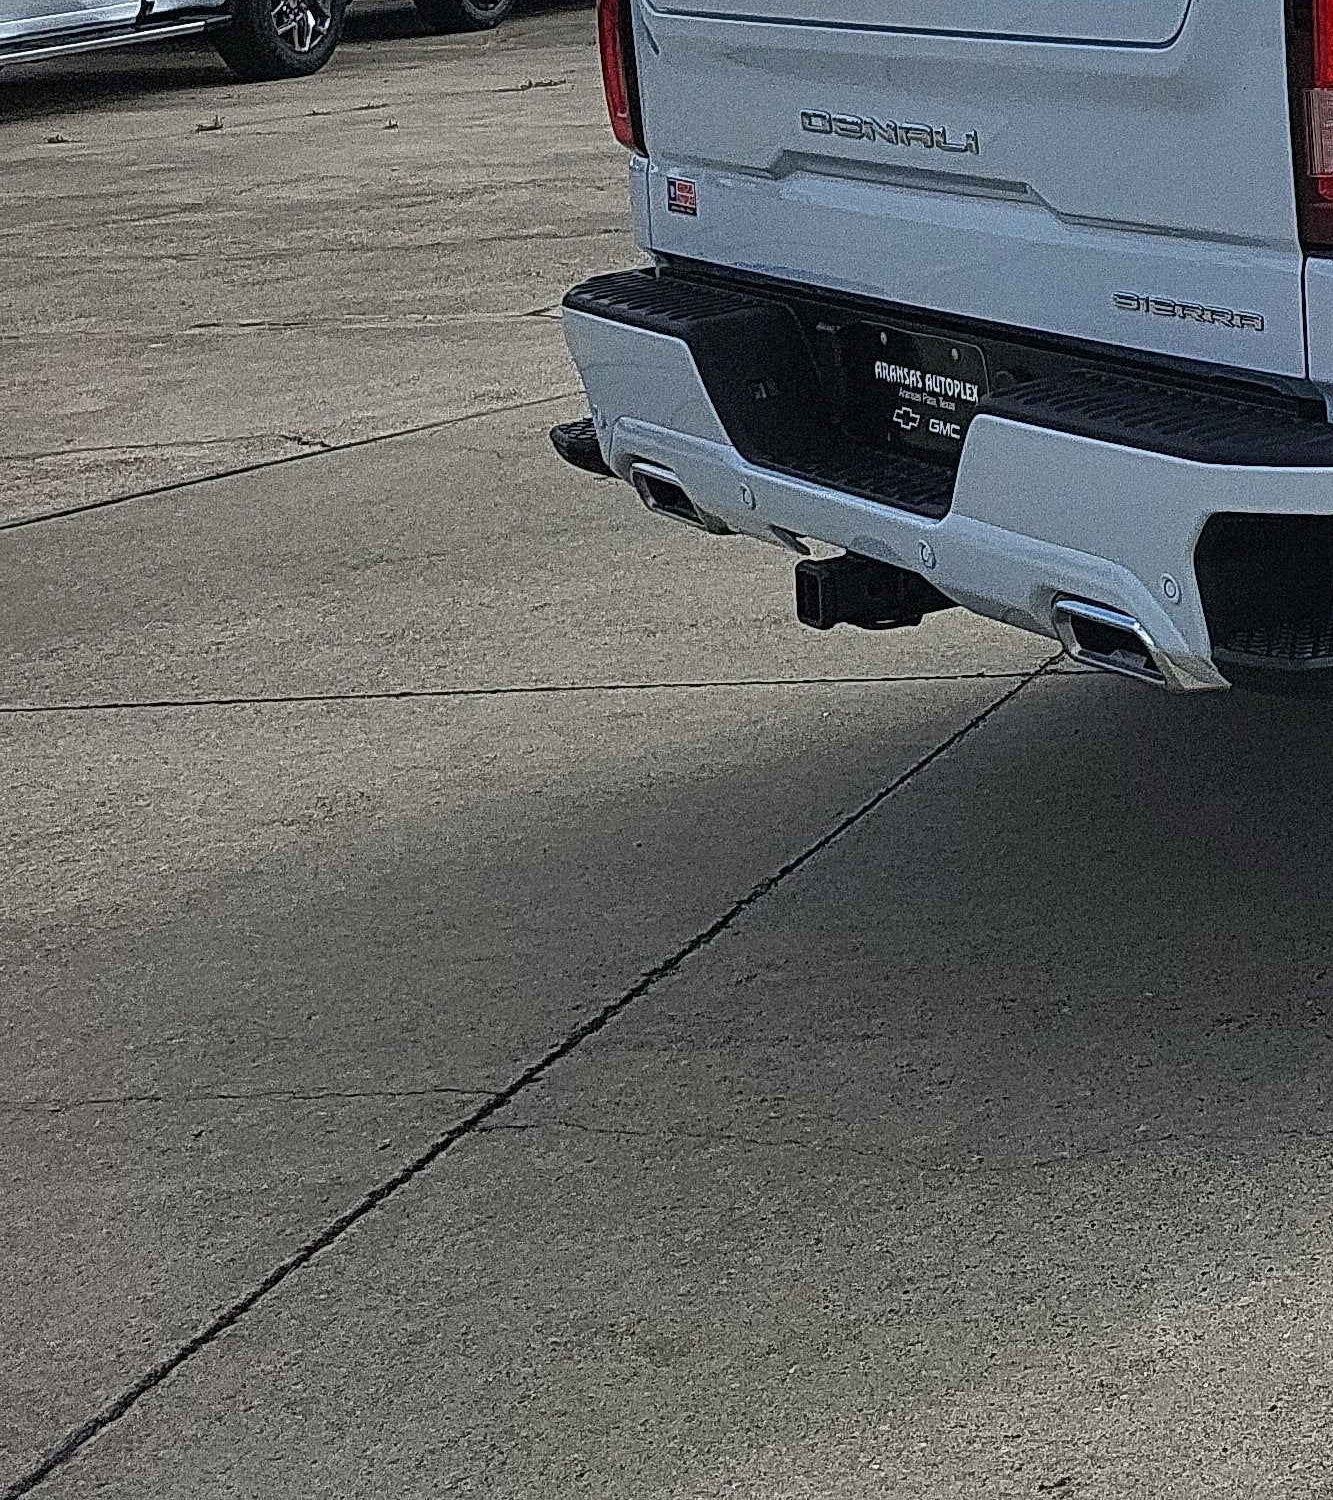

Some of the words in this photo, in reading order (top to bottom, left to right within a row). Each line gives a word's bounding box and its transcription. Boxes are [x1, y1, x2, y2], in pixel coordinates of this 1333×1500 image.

[800, 107, 980, 155] DENALI
[1112, 291, 1265, 331] SIERRA
[874, 360, 923, 389] ARANSAS
[925, 373, 979, 406] AUTOPLEX
[928, 418, 961, 440] GMC
